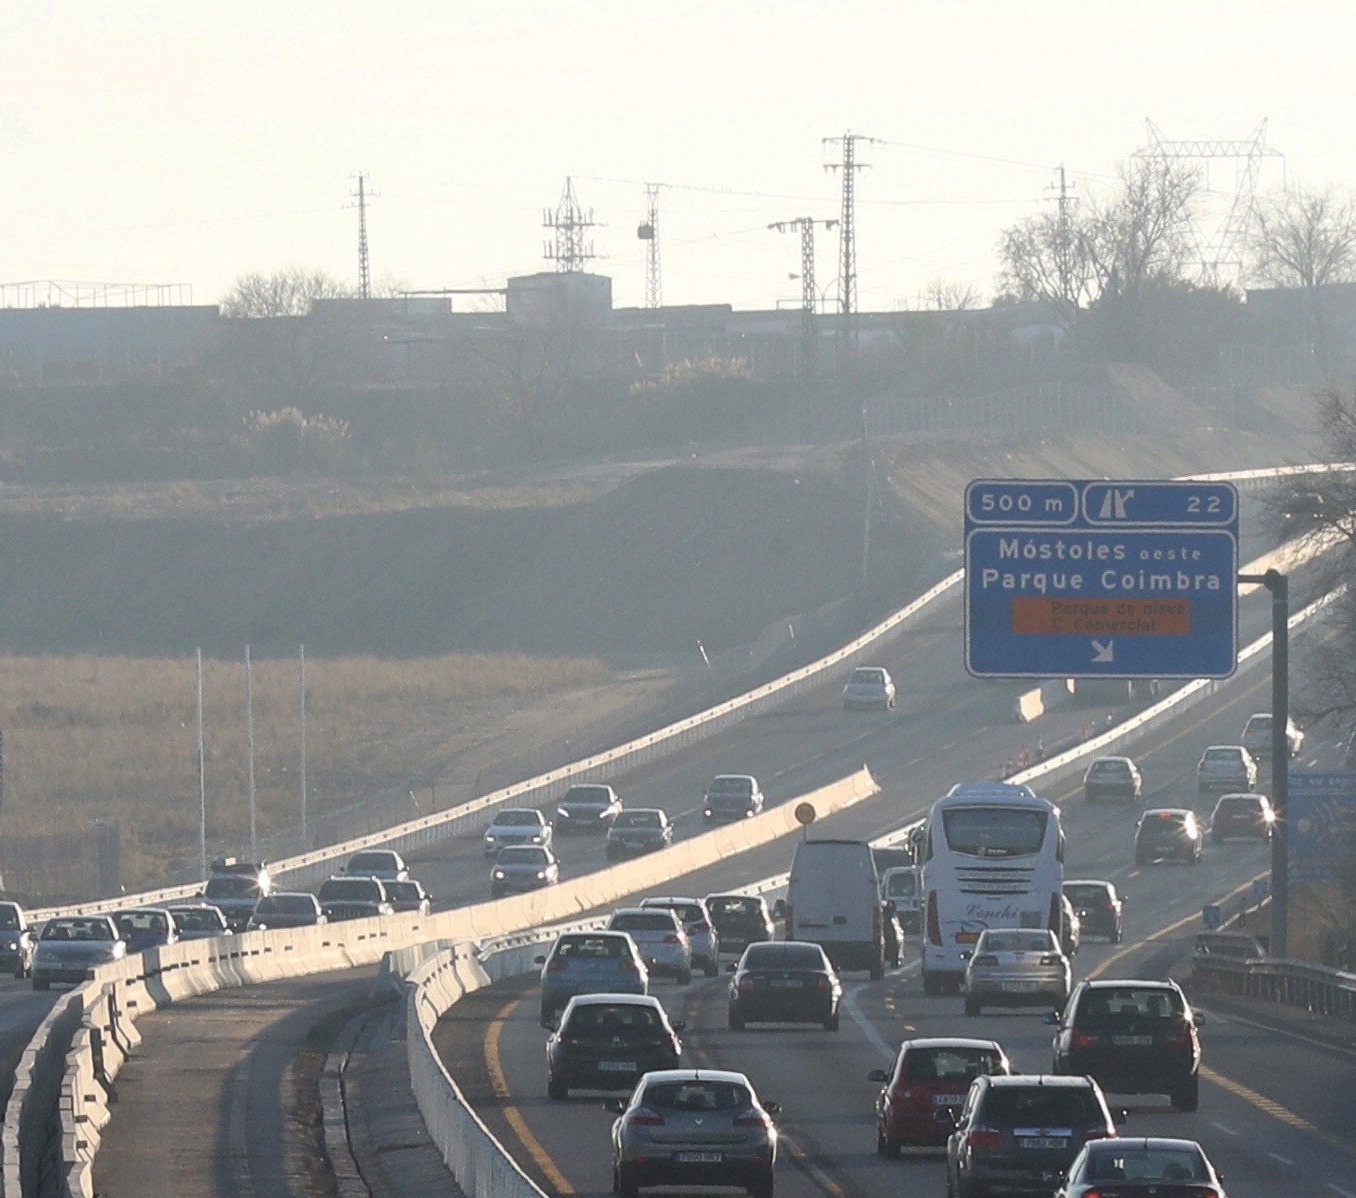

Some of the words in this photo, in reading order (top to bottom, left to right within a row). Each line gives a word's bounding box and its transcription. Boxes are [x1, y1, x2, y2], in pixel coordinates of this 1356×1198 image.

[981, 494, 1032, 512] 500
[1045, 498, 1063, 512] m
[1187, 496, 1221, 513] 22
[999, 538, 1126, 561] Móstoles
[1139, 547, 1202, 561] oeste
[982, 569, 1084, 593] Parque
[1101, 570, 1221, 590] Coimbra
[1051, 602, 1109, 616] Parque
[1117, 602, 1136, 614] de
